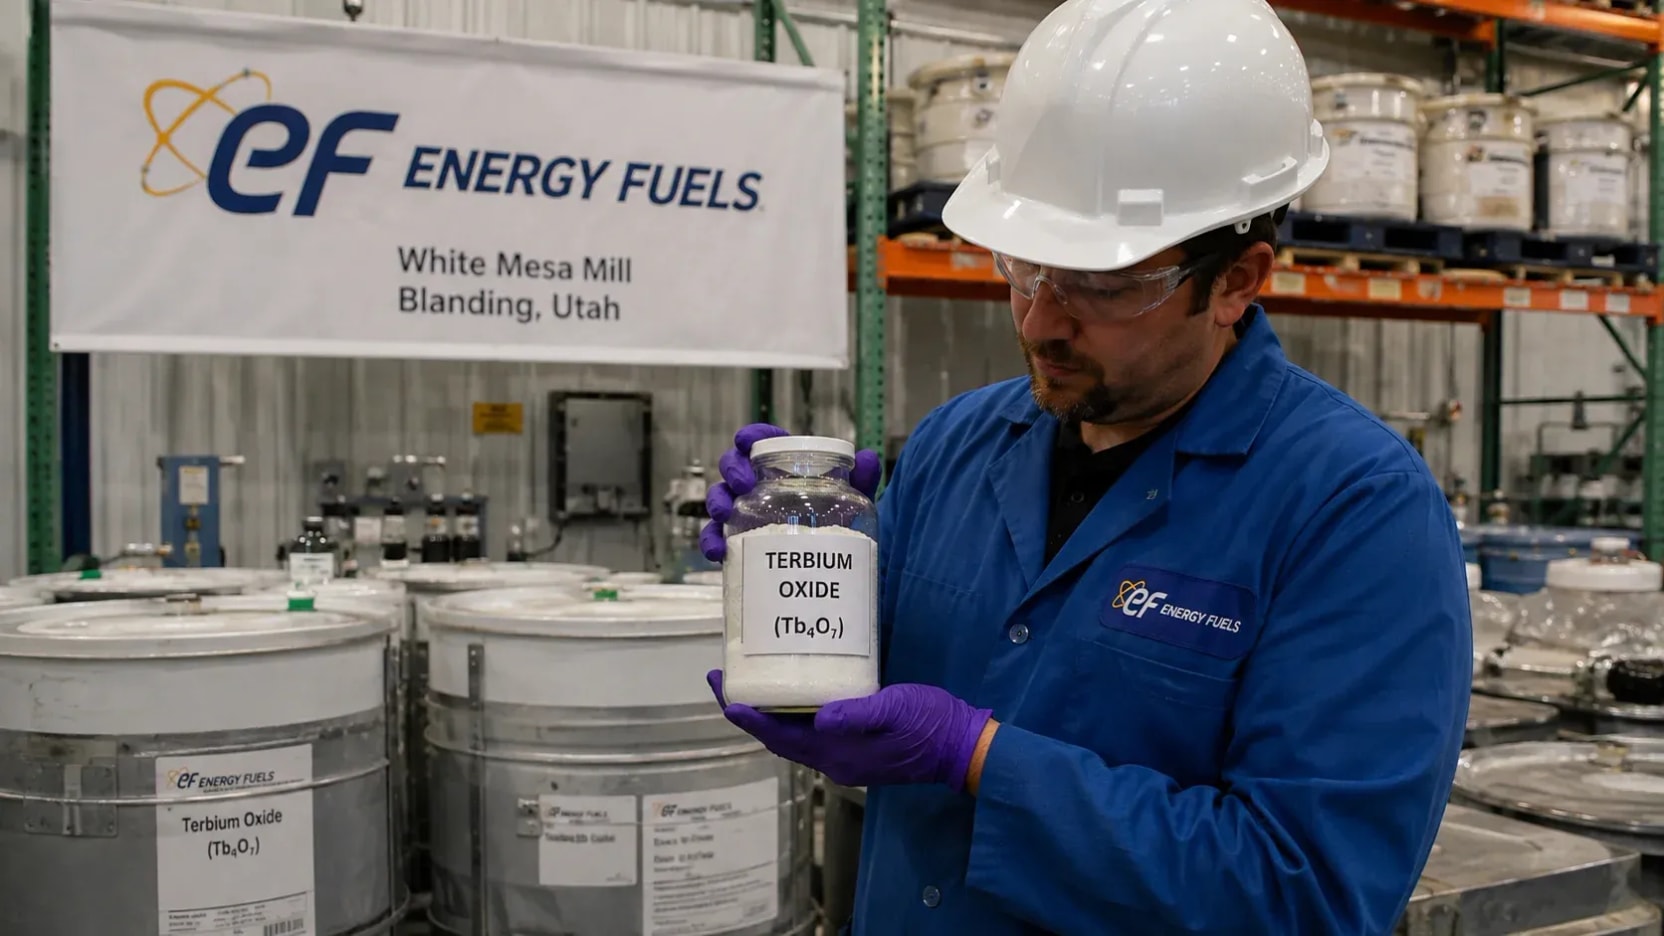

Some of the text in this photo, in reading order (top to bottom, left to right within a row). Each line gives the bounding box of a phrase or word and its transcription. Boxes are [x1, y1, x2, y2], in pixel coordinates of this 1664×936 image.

[404, 146, 611, 200] ENERGY
[618, 163, 763, 211] FUELS
[398, 246, 632, 283] White Mesa Mill
[399, 286, 620, 323] Blanding, Utah
[765, 552, 852, 570] TERBIUM
[779, 581, 840, 599] OXIDE
[1160, 603, 1206, 624] ENERGY
[1205, 615, 1241, 633] FUELS
[198, 775, 240, 788] ENERGY
[243, 770, 275, 785] FUELS
[182, 809, 283, 832] Terbium Oxide
